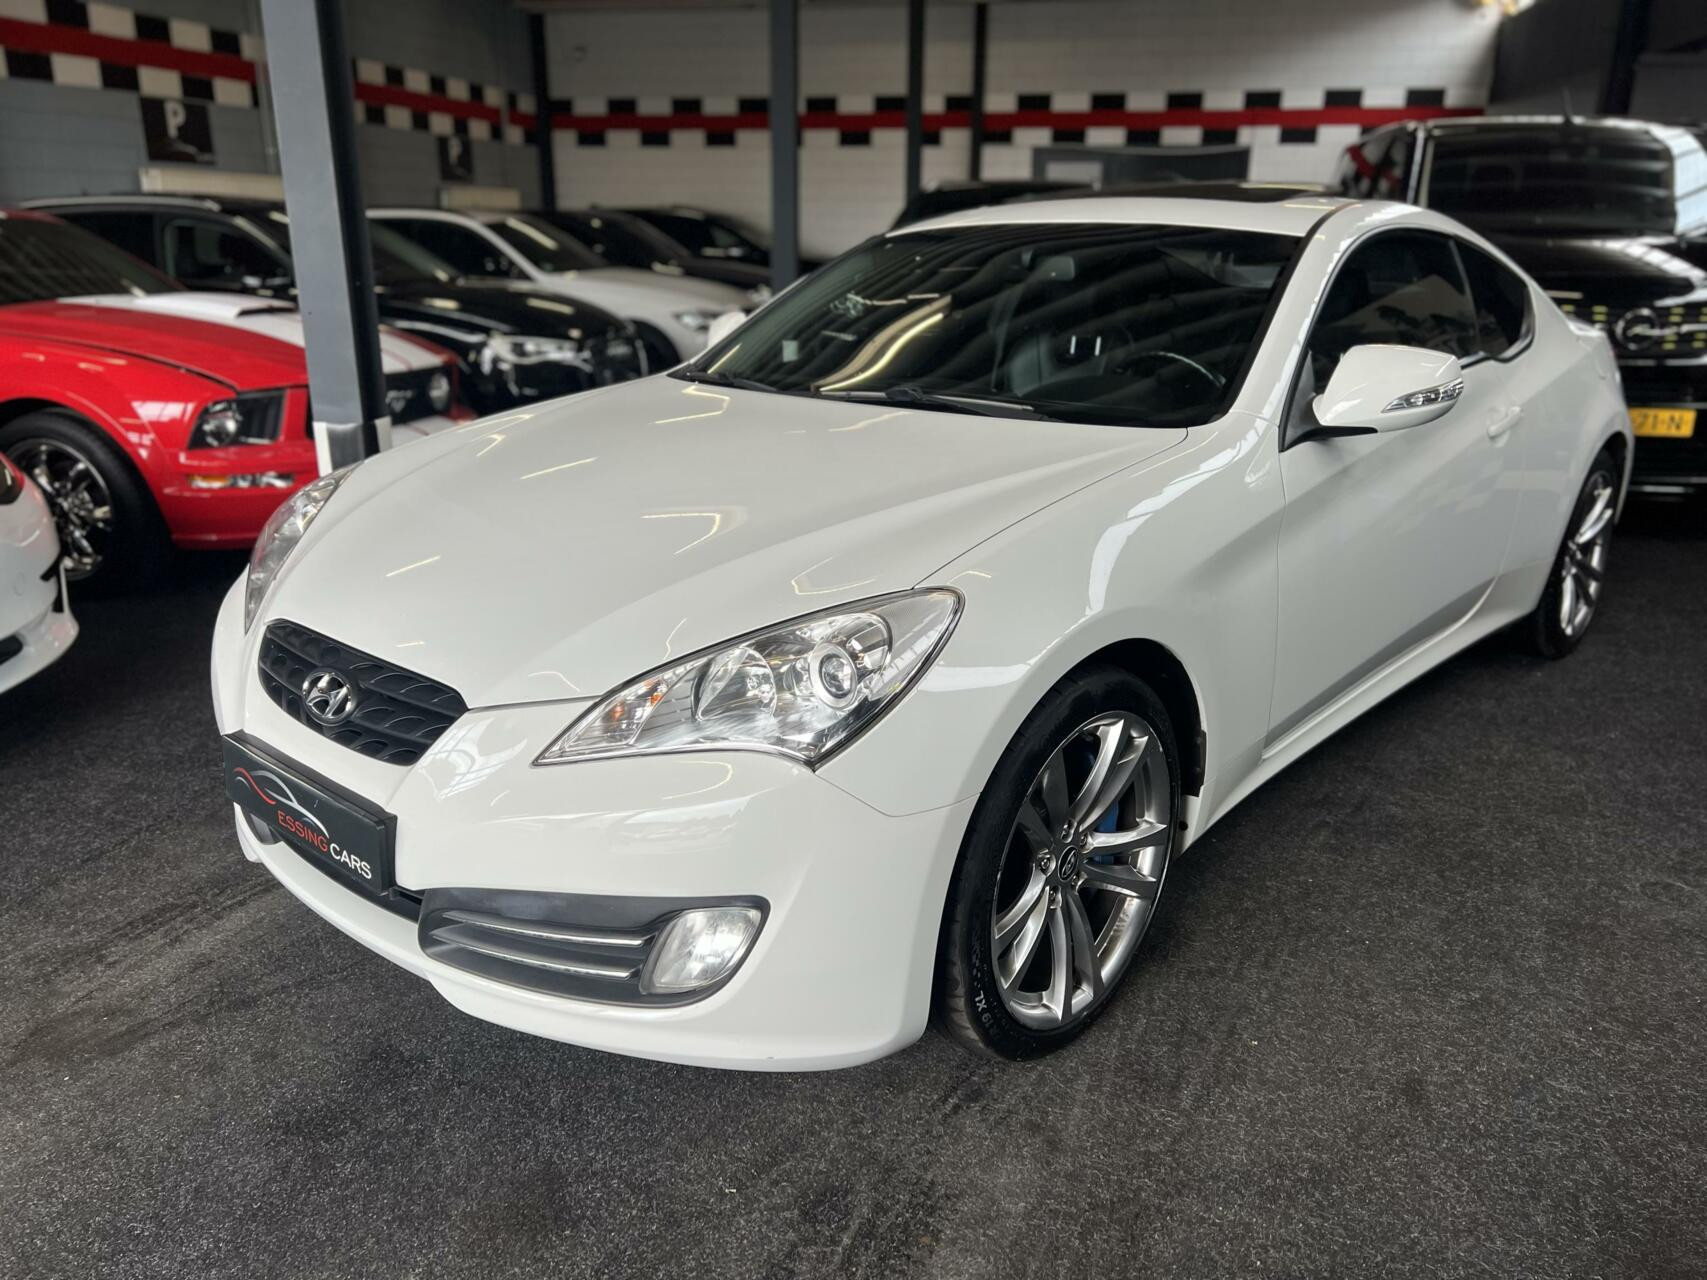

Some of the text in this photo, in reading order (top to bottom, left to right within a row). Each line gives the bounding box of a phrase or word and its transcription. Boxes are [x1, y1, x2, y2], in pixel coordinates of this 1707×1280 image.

[163, 100, 186, 139] P
[277, 810, 372, 880] ESSING CARS
[974, 989, 988, 1012] XL
